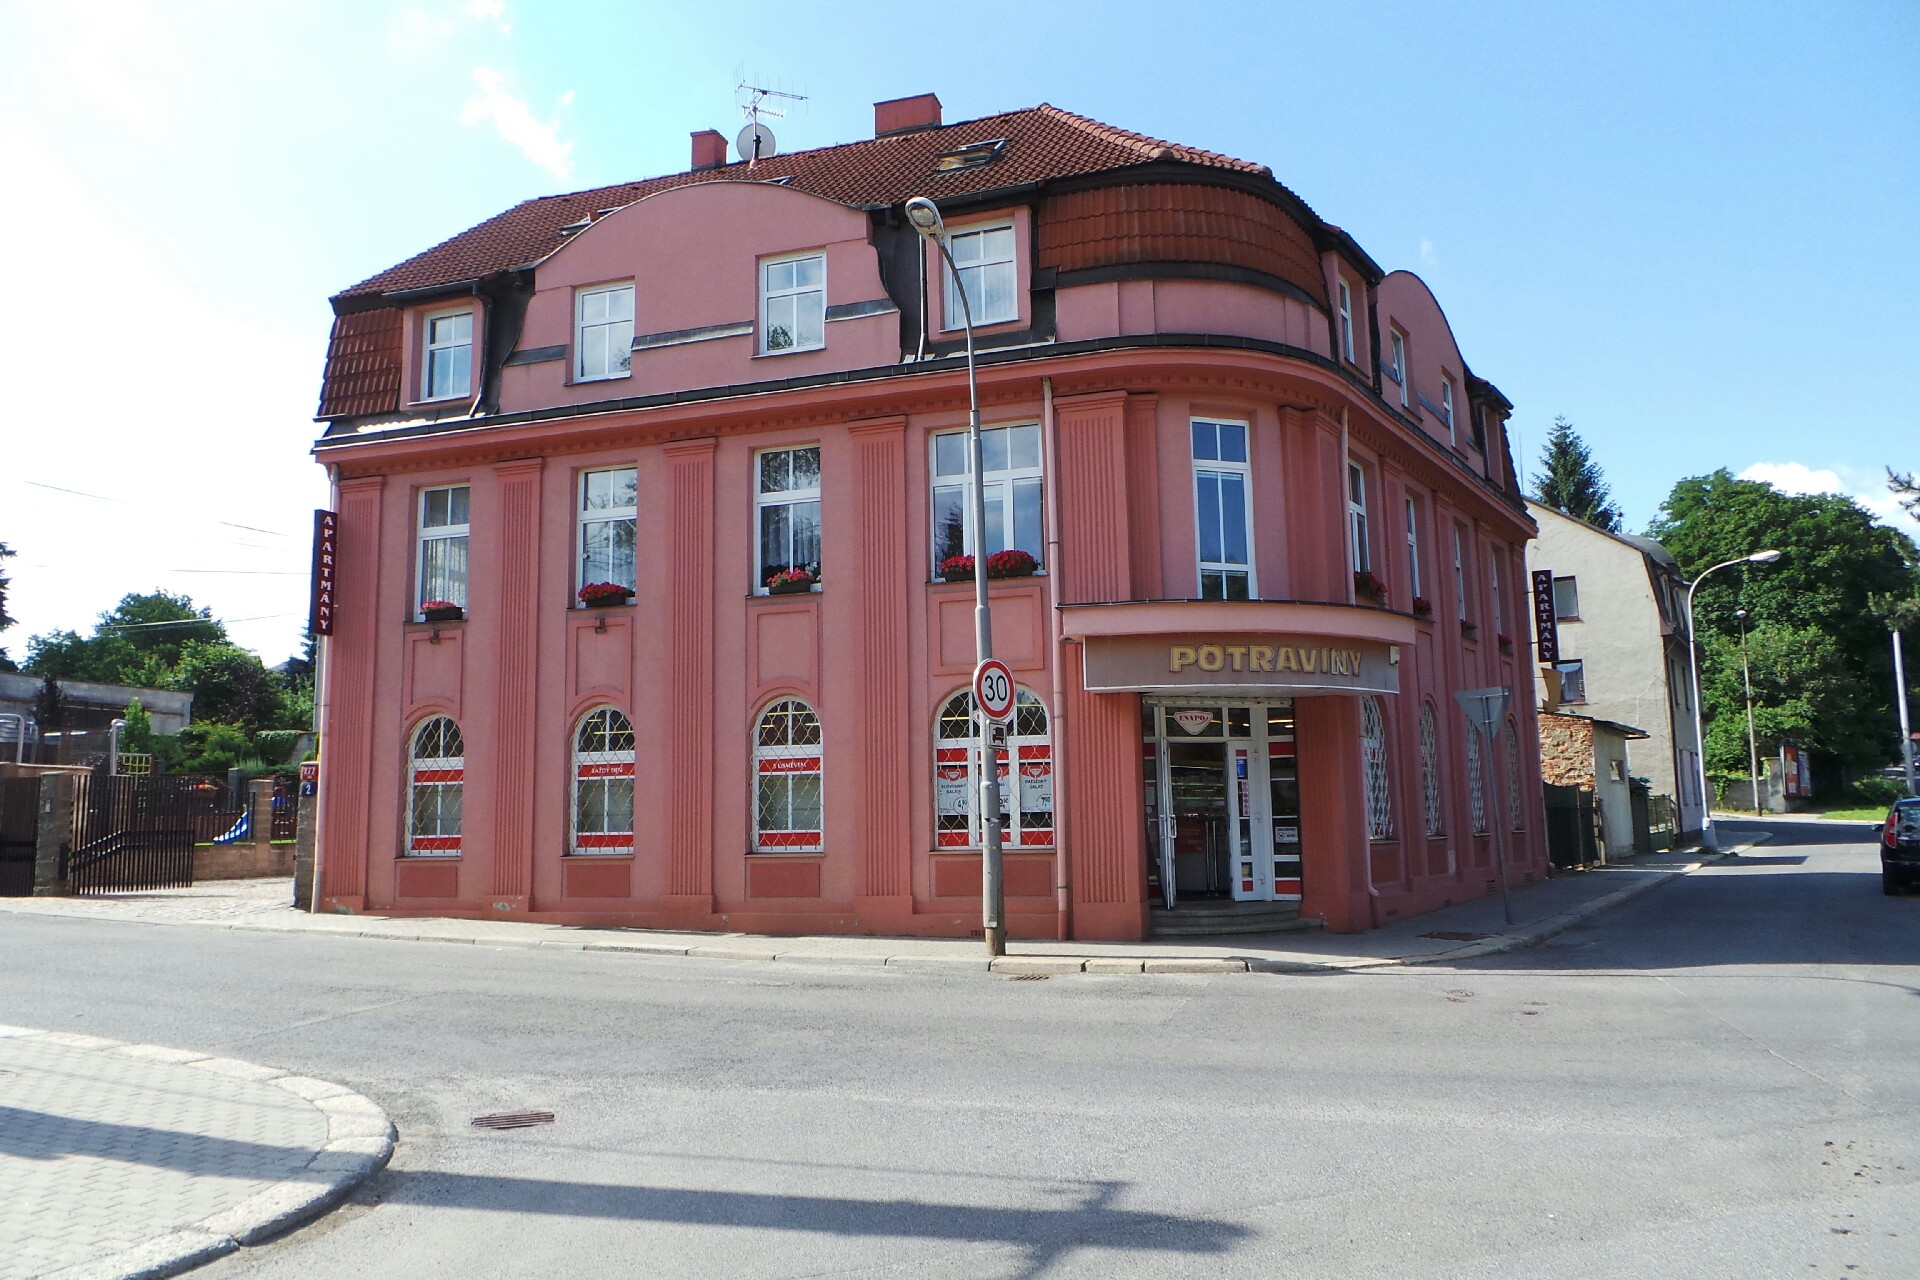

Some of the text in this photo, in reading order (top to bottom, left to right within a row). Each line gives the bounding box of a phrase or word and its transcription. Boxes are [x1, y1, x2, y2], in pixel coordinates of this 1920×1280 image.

[320, 515, 333, 630] APARTMÁNY
[1537, 574, 1553, 659] APARTMÁNY
[1169, 644, 1362, 677] POTRAVINY
[984, 674, 1008, 702] 30
[305, 784, 311, 795] 2
